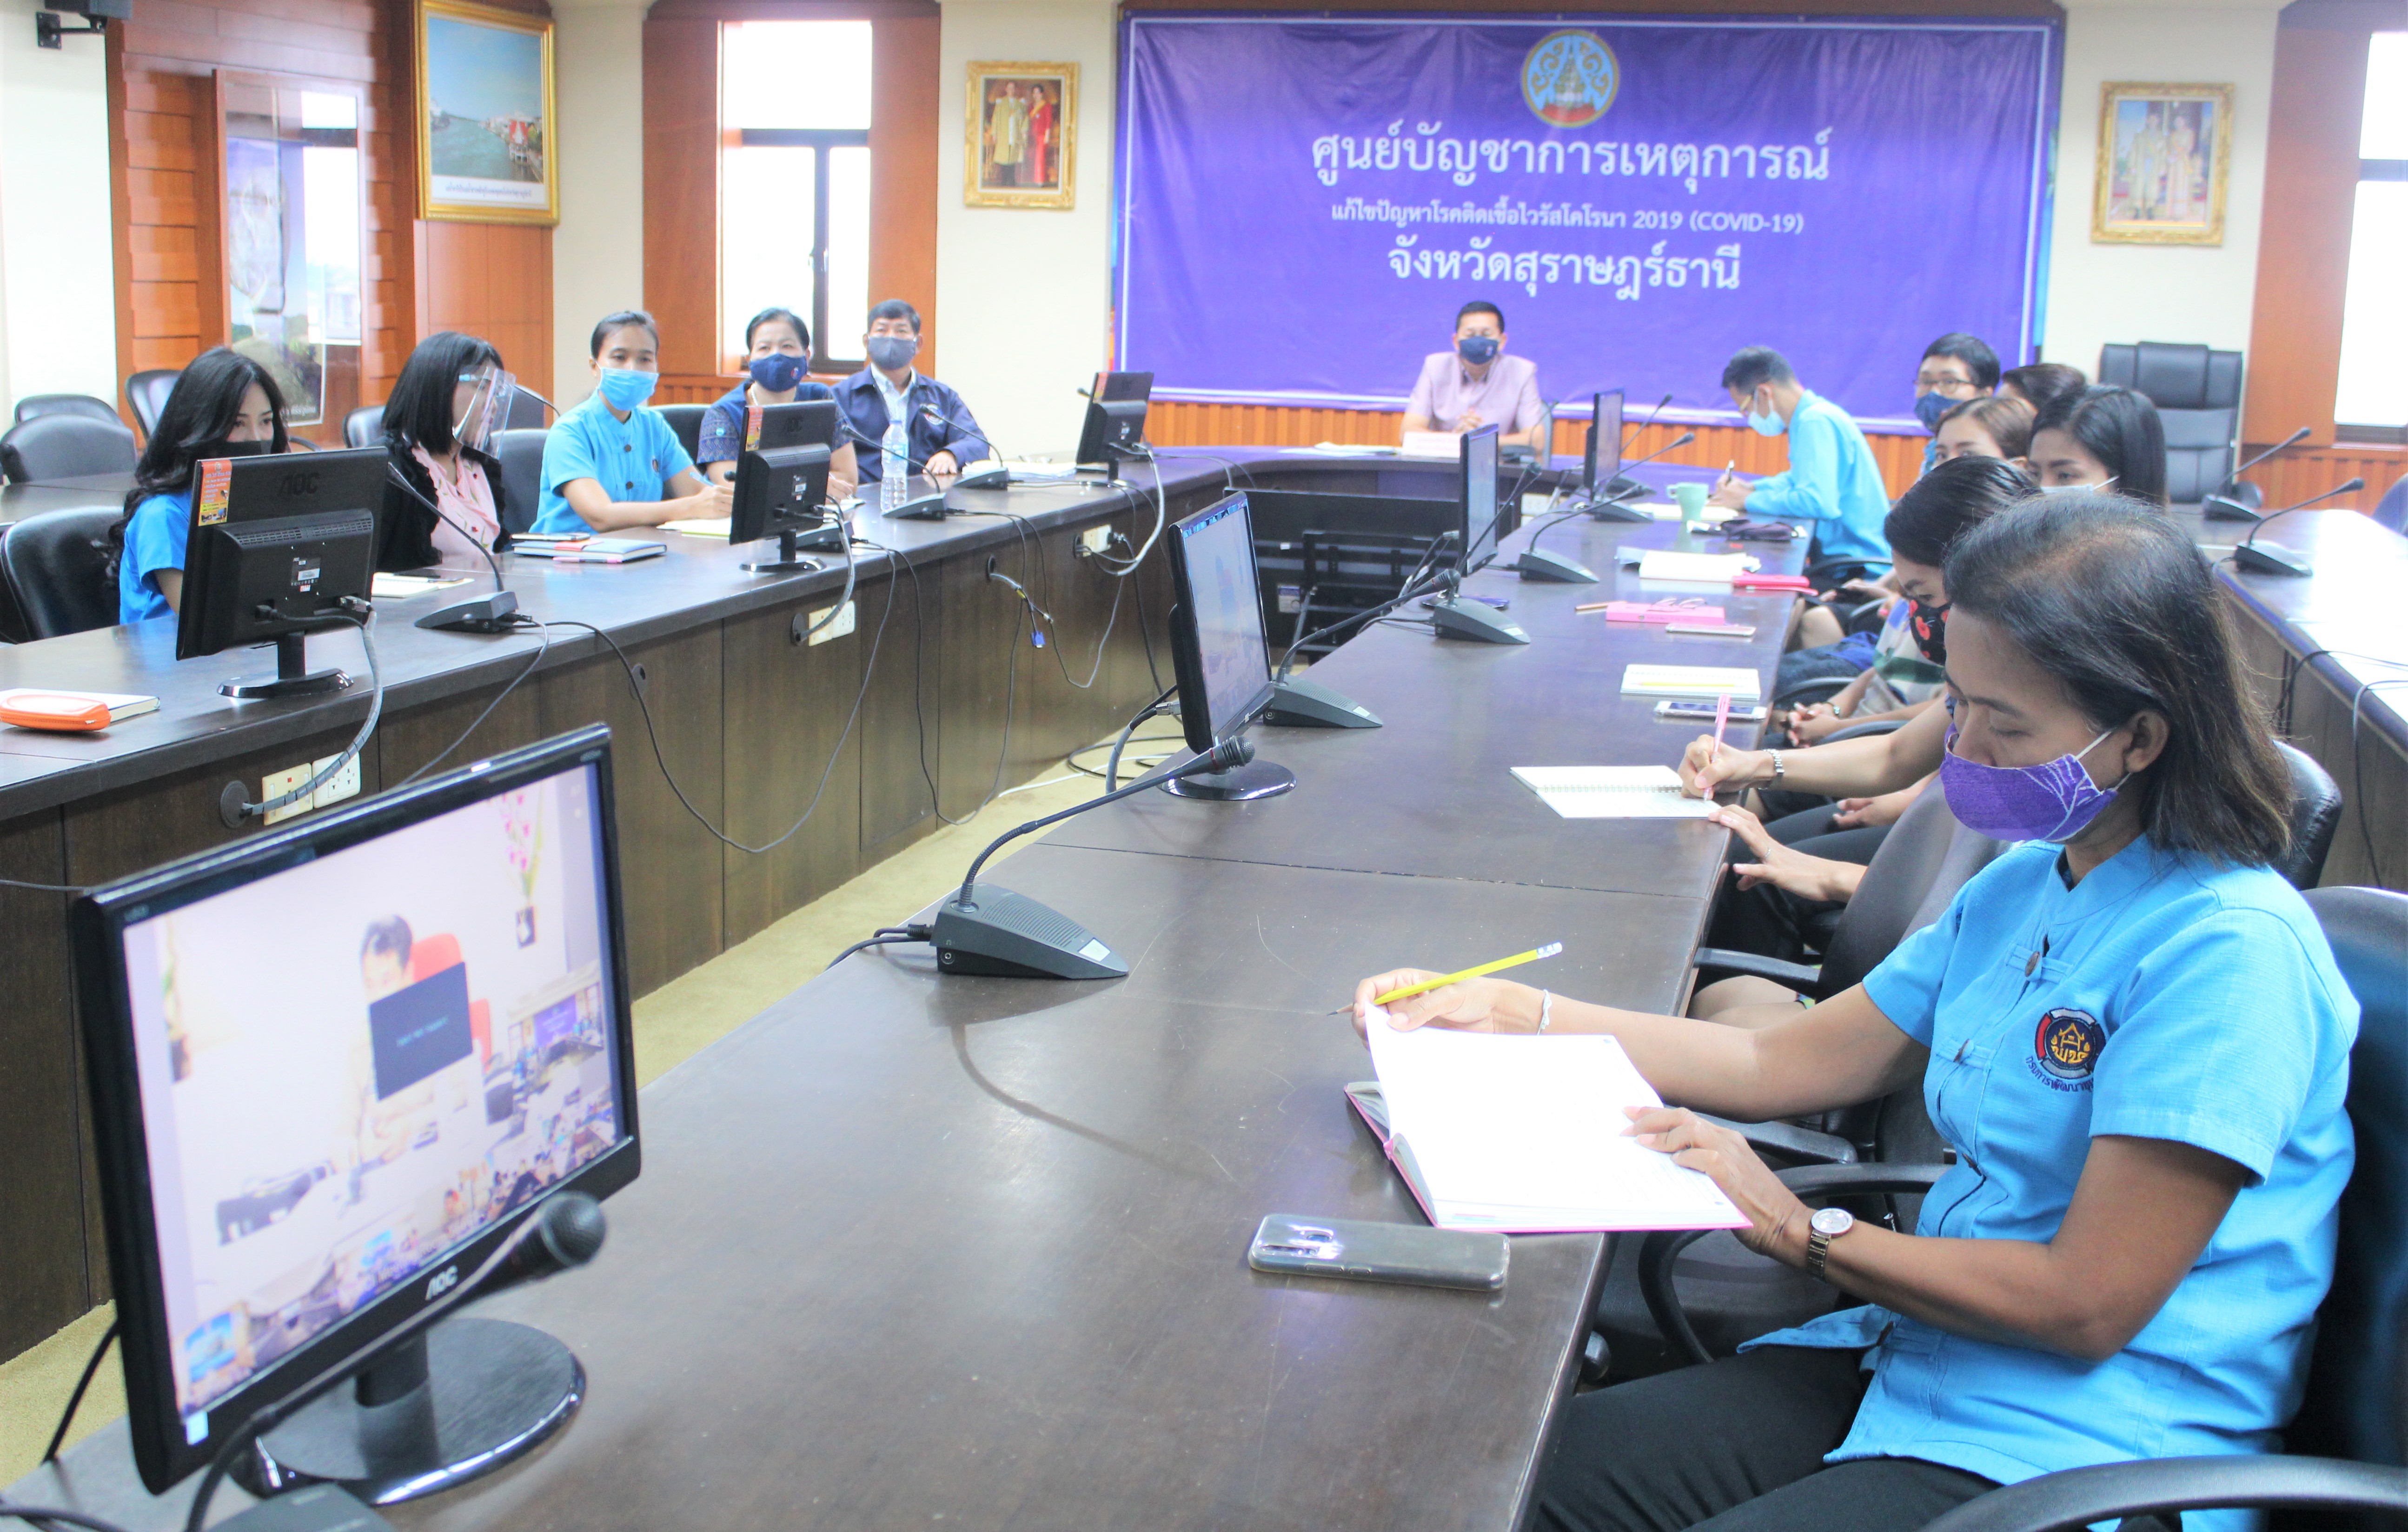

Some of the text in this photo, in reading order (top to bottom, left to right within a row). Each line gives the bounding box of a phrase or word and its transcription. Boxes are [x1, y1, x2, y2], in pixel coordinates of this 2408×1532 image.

[1312, 118, 1833, 195] ศูนย์บัญชาการเหตุการณ์
[1332, 196, 1804, 234] แก้ไขปัญหาโรคติดเชื้อไวรัสโคโรนา 2019 (COVID-19)
[1388, 233, 1741, 301] จังหวัดสุราษฎร์ธานี
[279, 472, 320, 496] AOC
[425, 1265, 458, 1300] AOC
